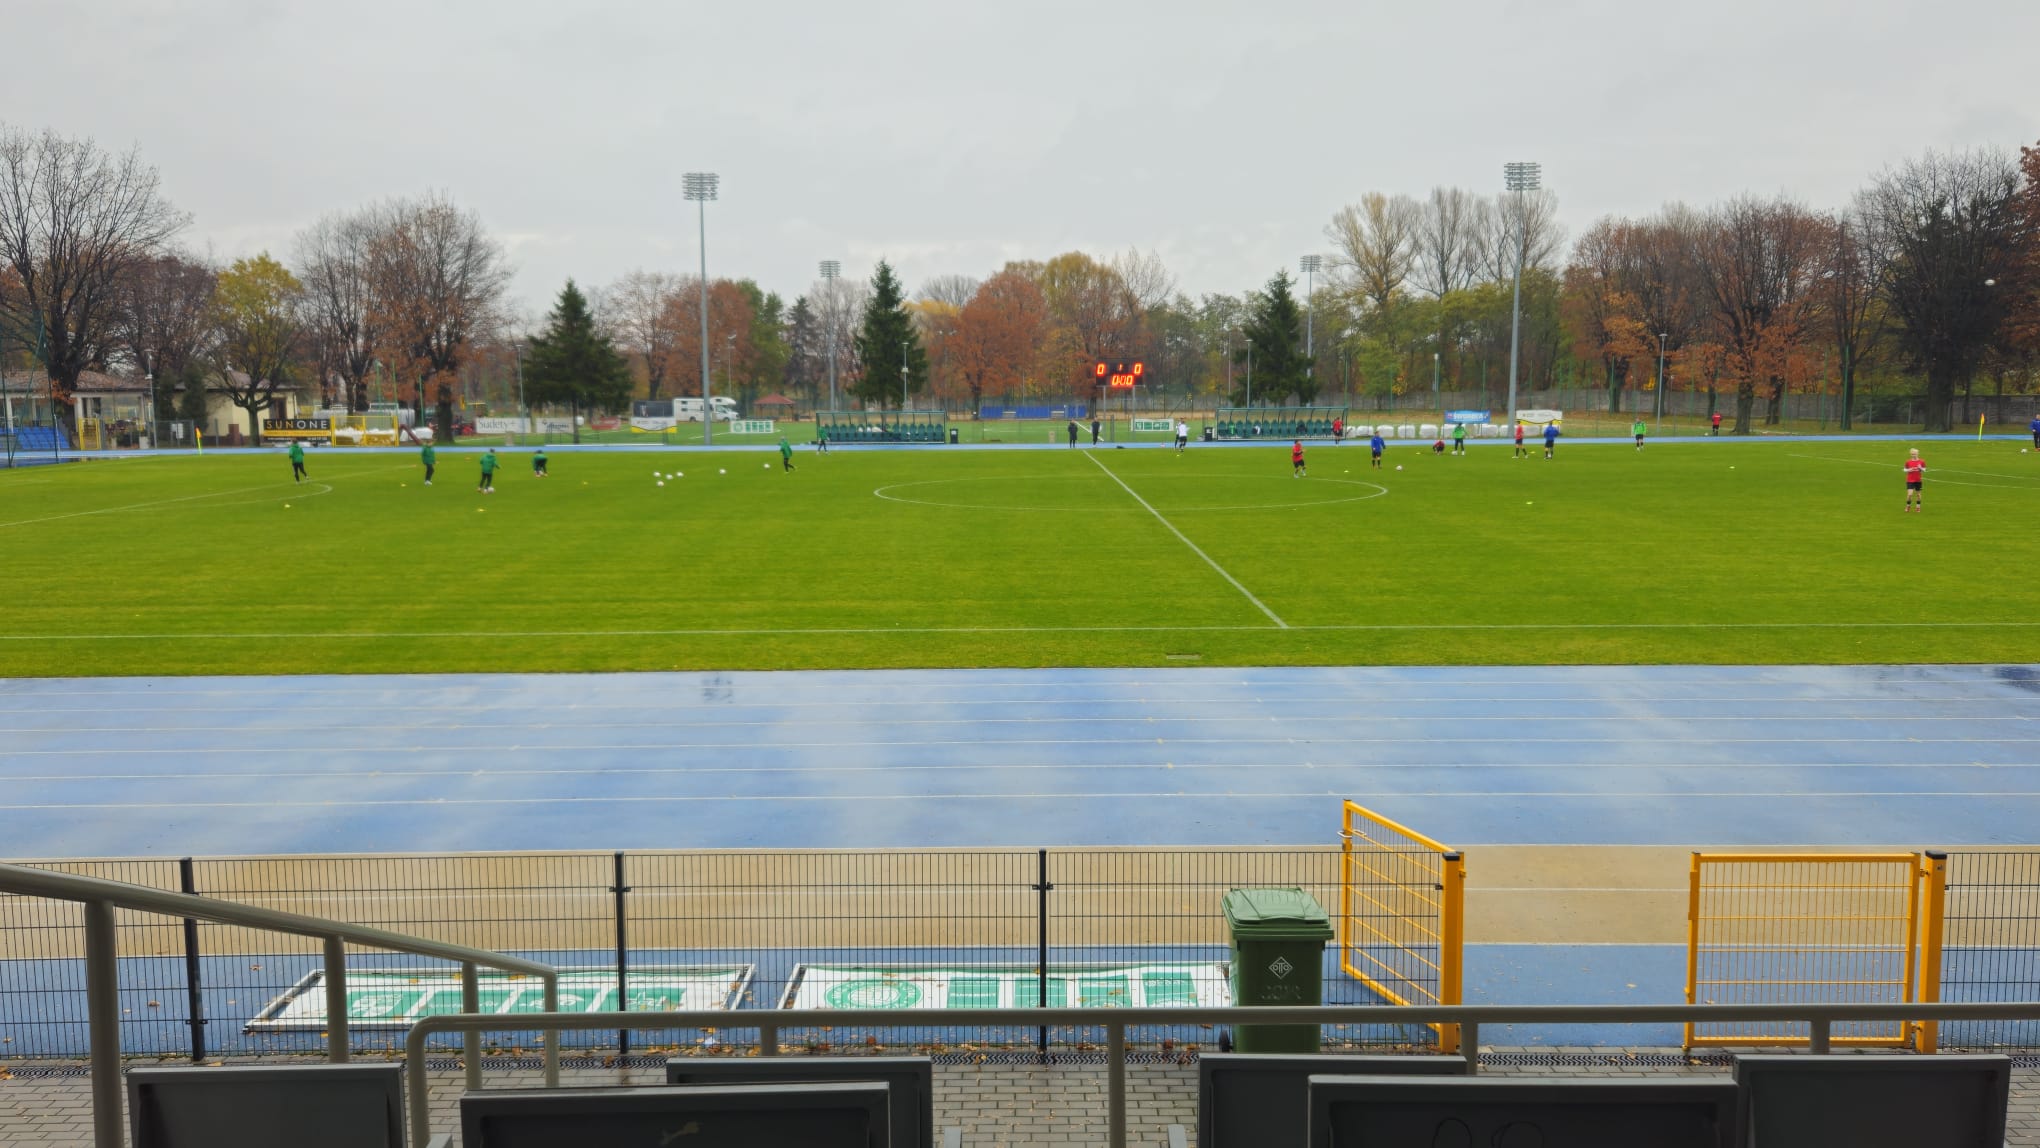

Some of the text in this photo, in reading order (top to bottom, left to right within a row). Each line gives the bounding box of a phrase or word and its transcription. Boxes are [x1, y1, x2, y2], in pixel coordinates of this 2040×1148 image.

[1096, 363, 1105, 375] 0
[1134, 363, 1142, 375] 0
[266, 420, 328, 430] SUNONE
[1272, 963, 1290, 974] OTTO
